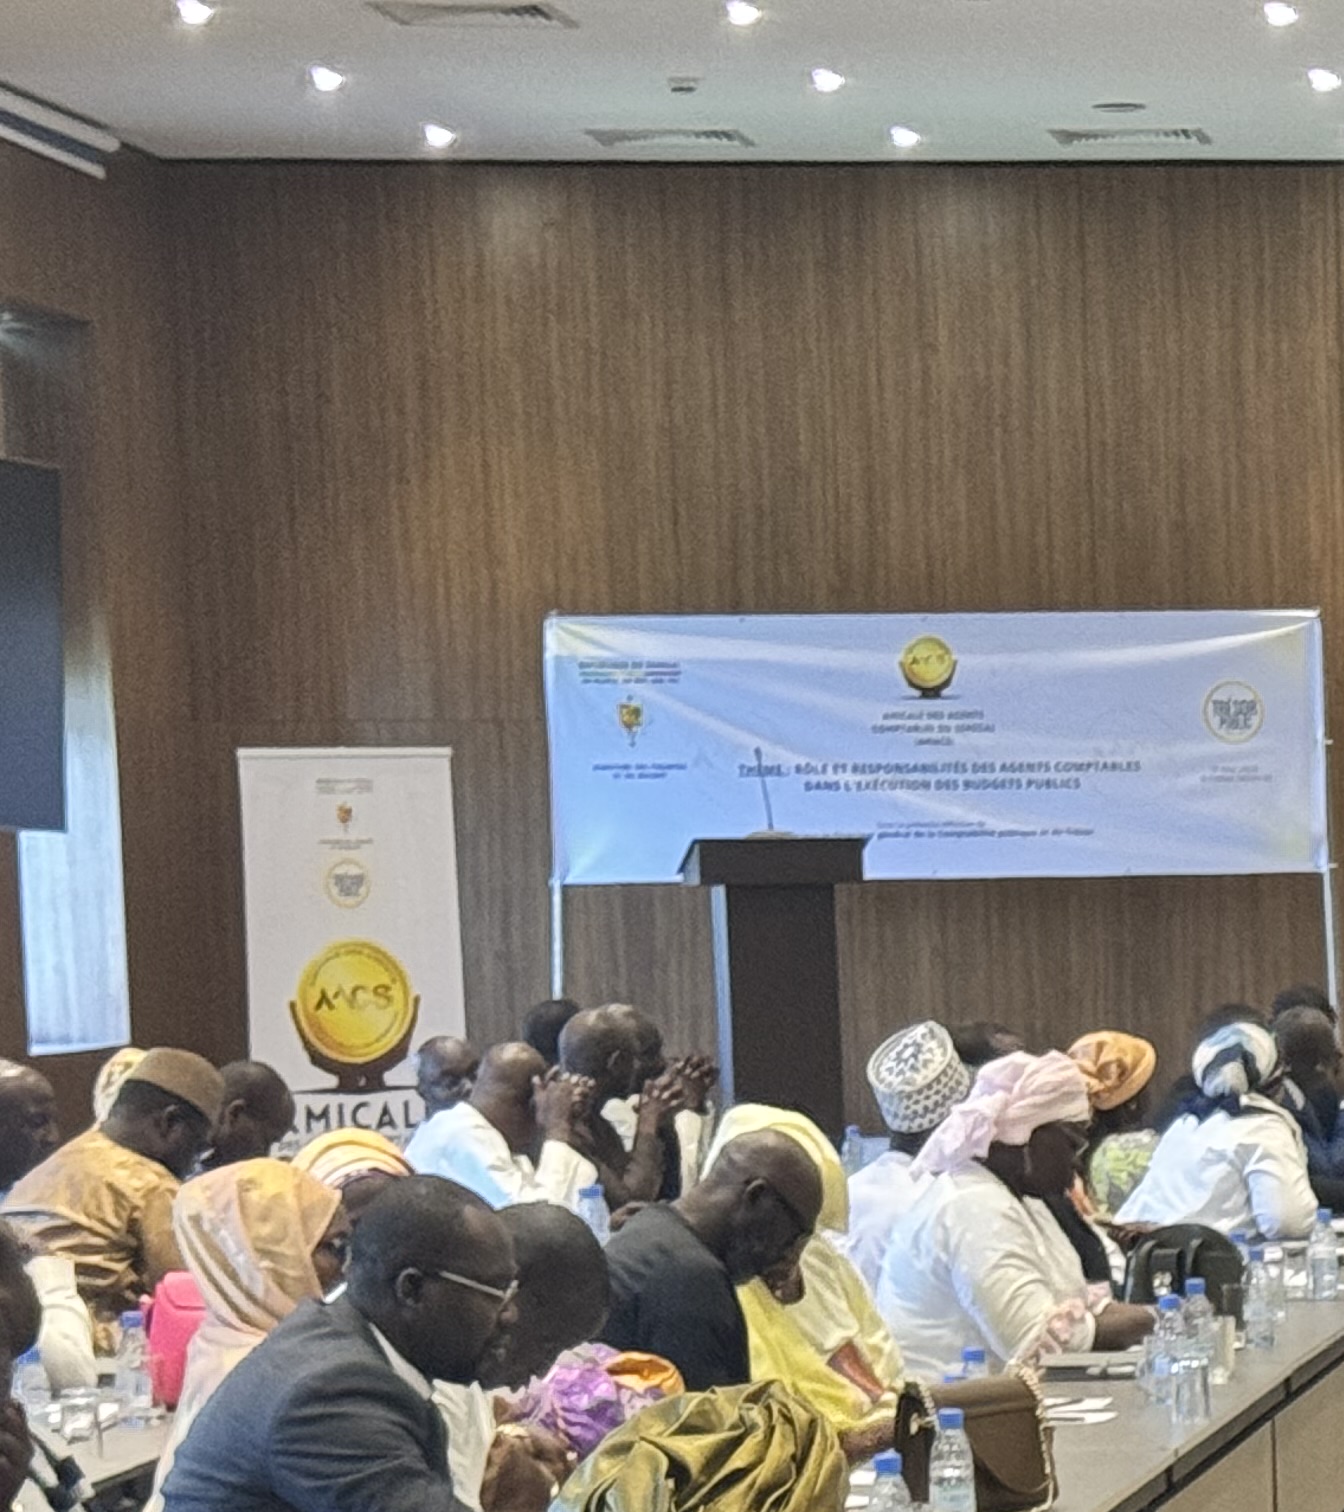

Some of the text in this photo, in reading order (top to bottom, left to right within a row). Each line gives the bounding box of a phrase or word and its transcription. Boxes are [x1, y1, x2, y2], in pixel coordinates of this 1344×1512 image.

[795, 761, 829, 775] RÔLE
[832, 763, 848, 775] ET
[851, 760, 968, 774] RESPONSABILITÉS
[971, 761, 997, 774] DES
[999, 761, 1051, 774] AGENTS
[1053, 760, 1142, 773] COMPTABLES
[804, 777, 1081, 792] DANS L'EXÉCUTION DES BUDGETS PUBLICS
[294, 1100, 419, 1134] MICAL
